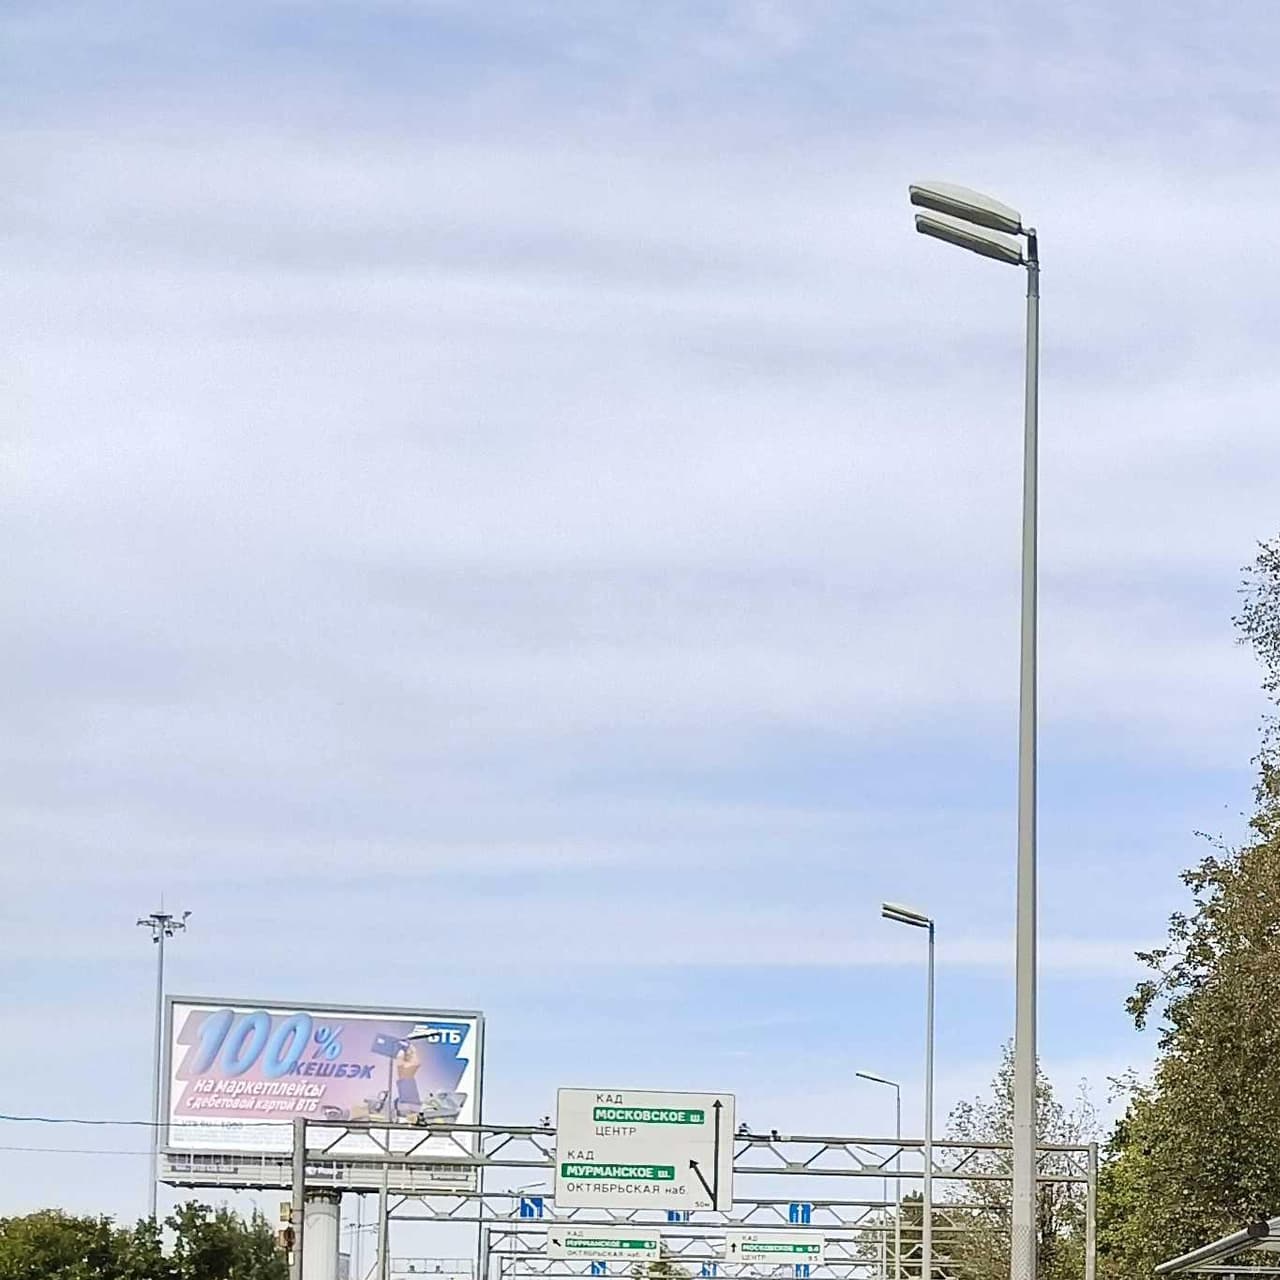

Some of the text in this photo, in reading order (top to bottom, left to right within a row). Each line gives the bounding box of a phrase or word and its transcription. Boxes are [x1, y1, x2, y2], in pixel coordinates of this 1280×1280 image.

[192, 1009, 342, 1079] 100%
[288, 1061, 375, 1079] КЕШБЭК
[194, 1079, 326, 1098] на маркетплейсы
[193, 1094, 254, 1110] дебетовой
[255, 1099, 294, 1113] картой
[295, 1101, 320, 1111] ВТБ
[596, 1094, 623, 1104] КАД
[595, 1108, 704, 1123] МОСКОВСКОЕ ш.
[595, 1127, 637, 1136] ЦЕНТР
[567, 1150, 594, 1160] КАД
[566, 1166, 654, 1177] МУРМАНСКОЕ
[567, 1183, 660, 1194] ОКТЯБРЬСКАЯ
